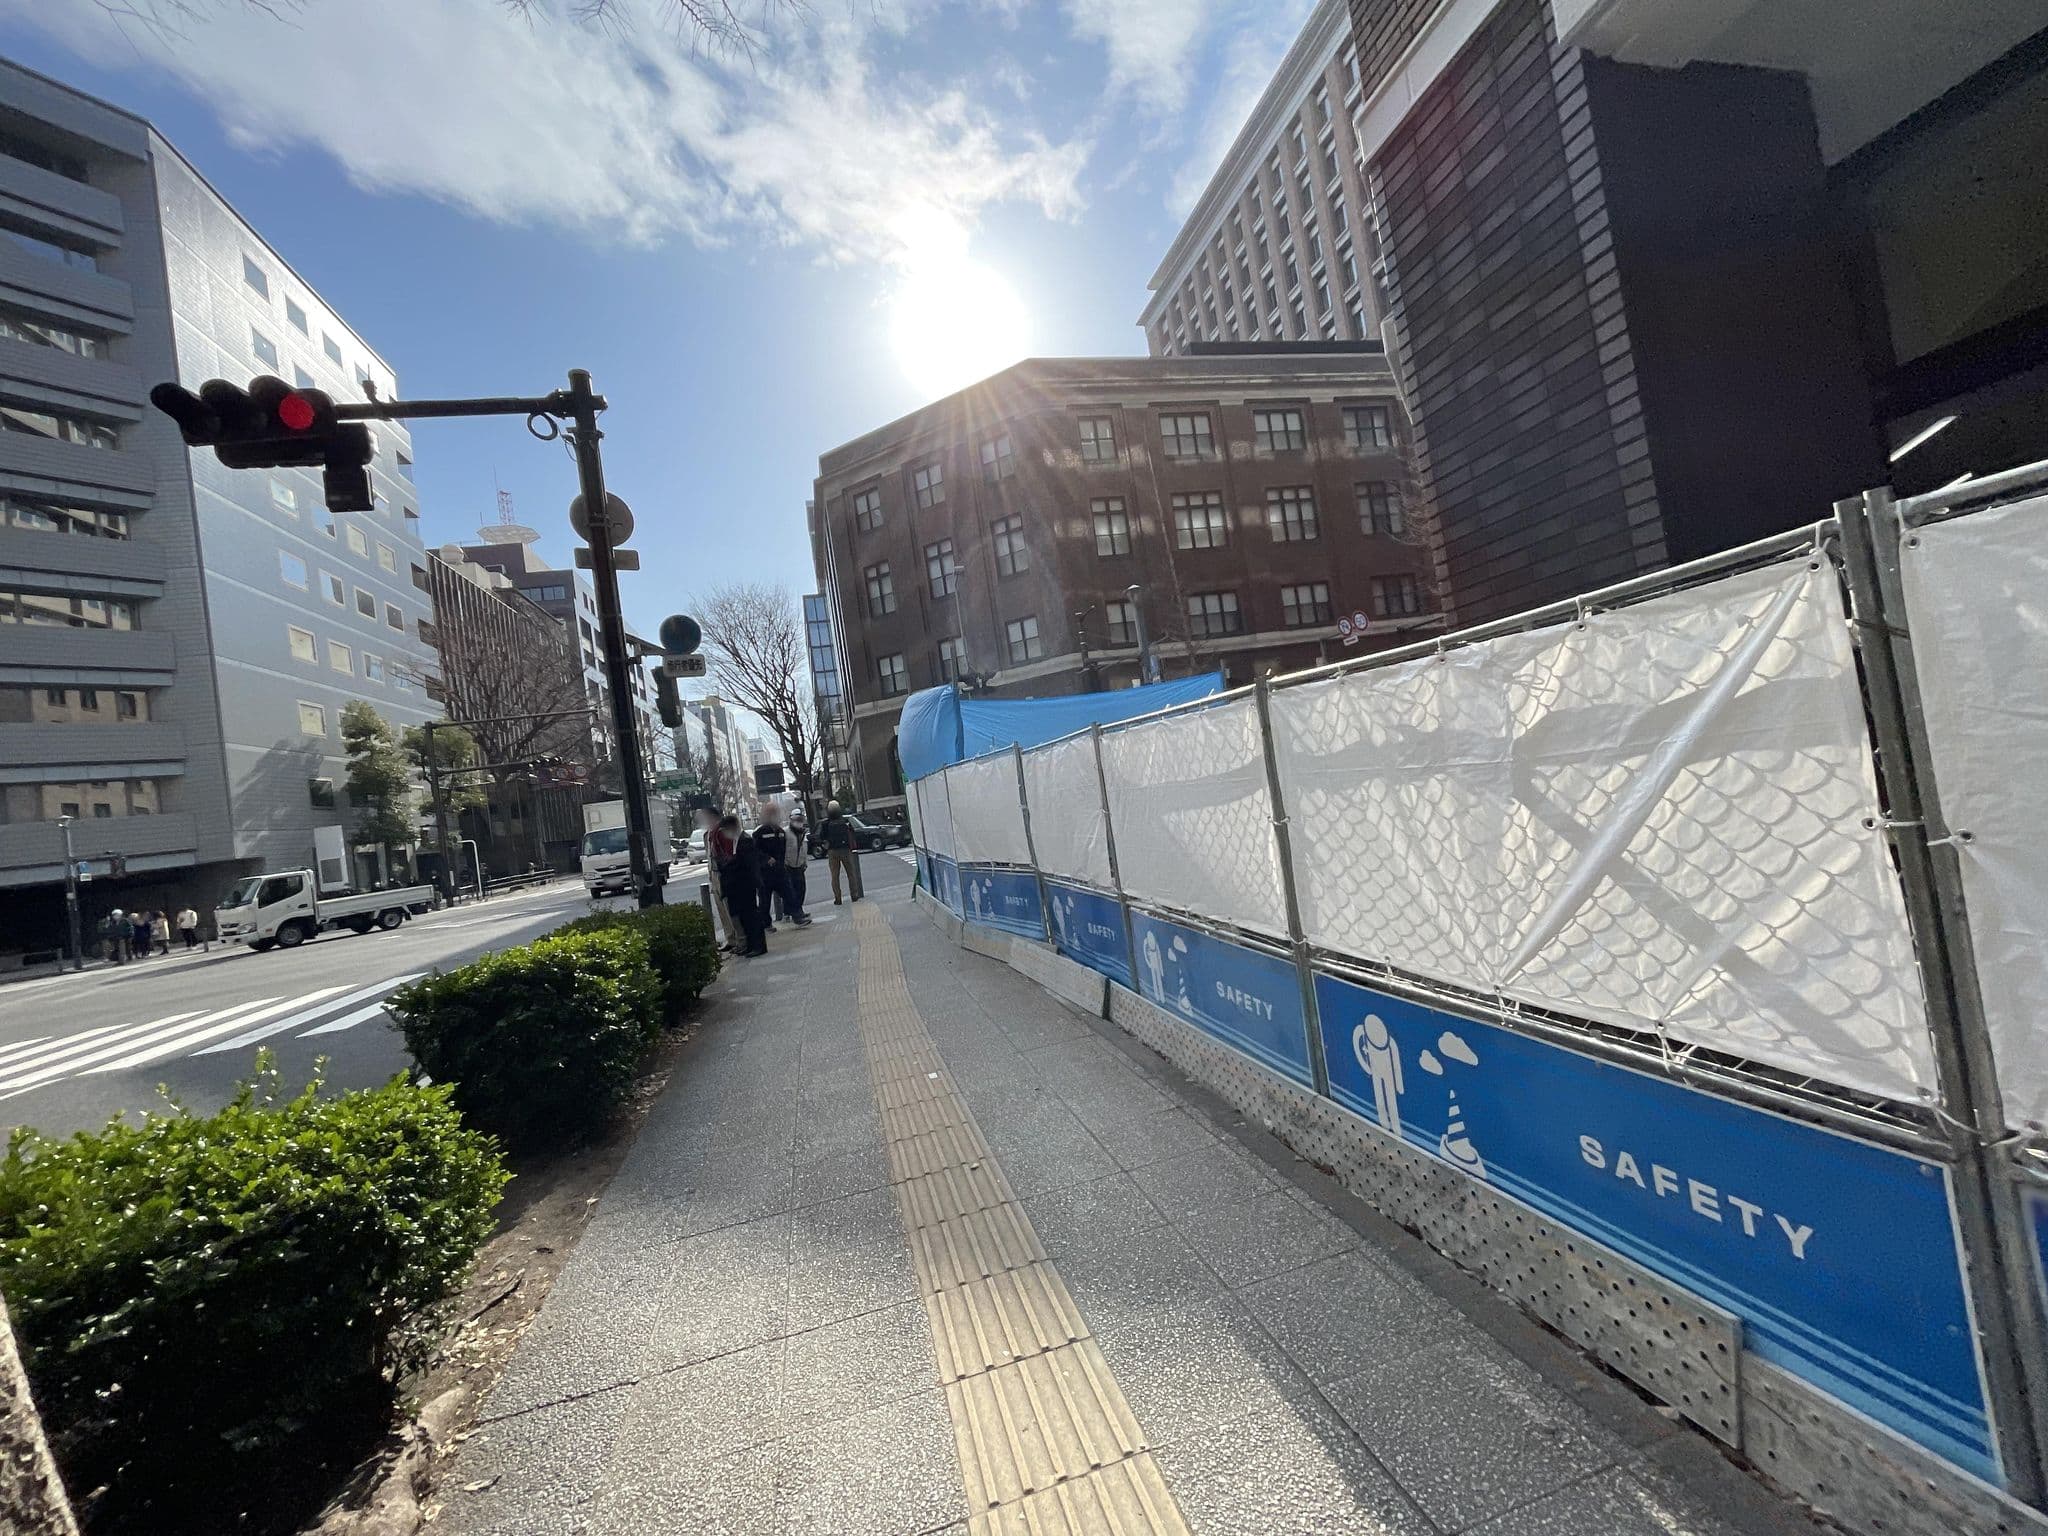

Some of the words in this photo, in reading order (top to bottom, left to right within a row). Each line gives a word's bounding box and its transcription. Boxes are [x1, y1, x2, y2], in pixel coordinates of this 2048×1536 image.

[1087, 922, 1116, 942] SAFETY
[1215, 980, 1273, 1021] SAFETY
[1579, 1134, 1814, 1260] SAFETY
